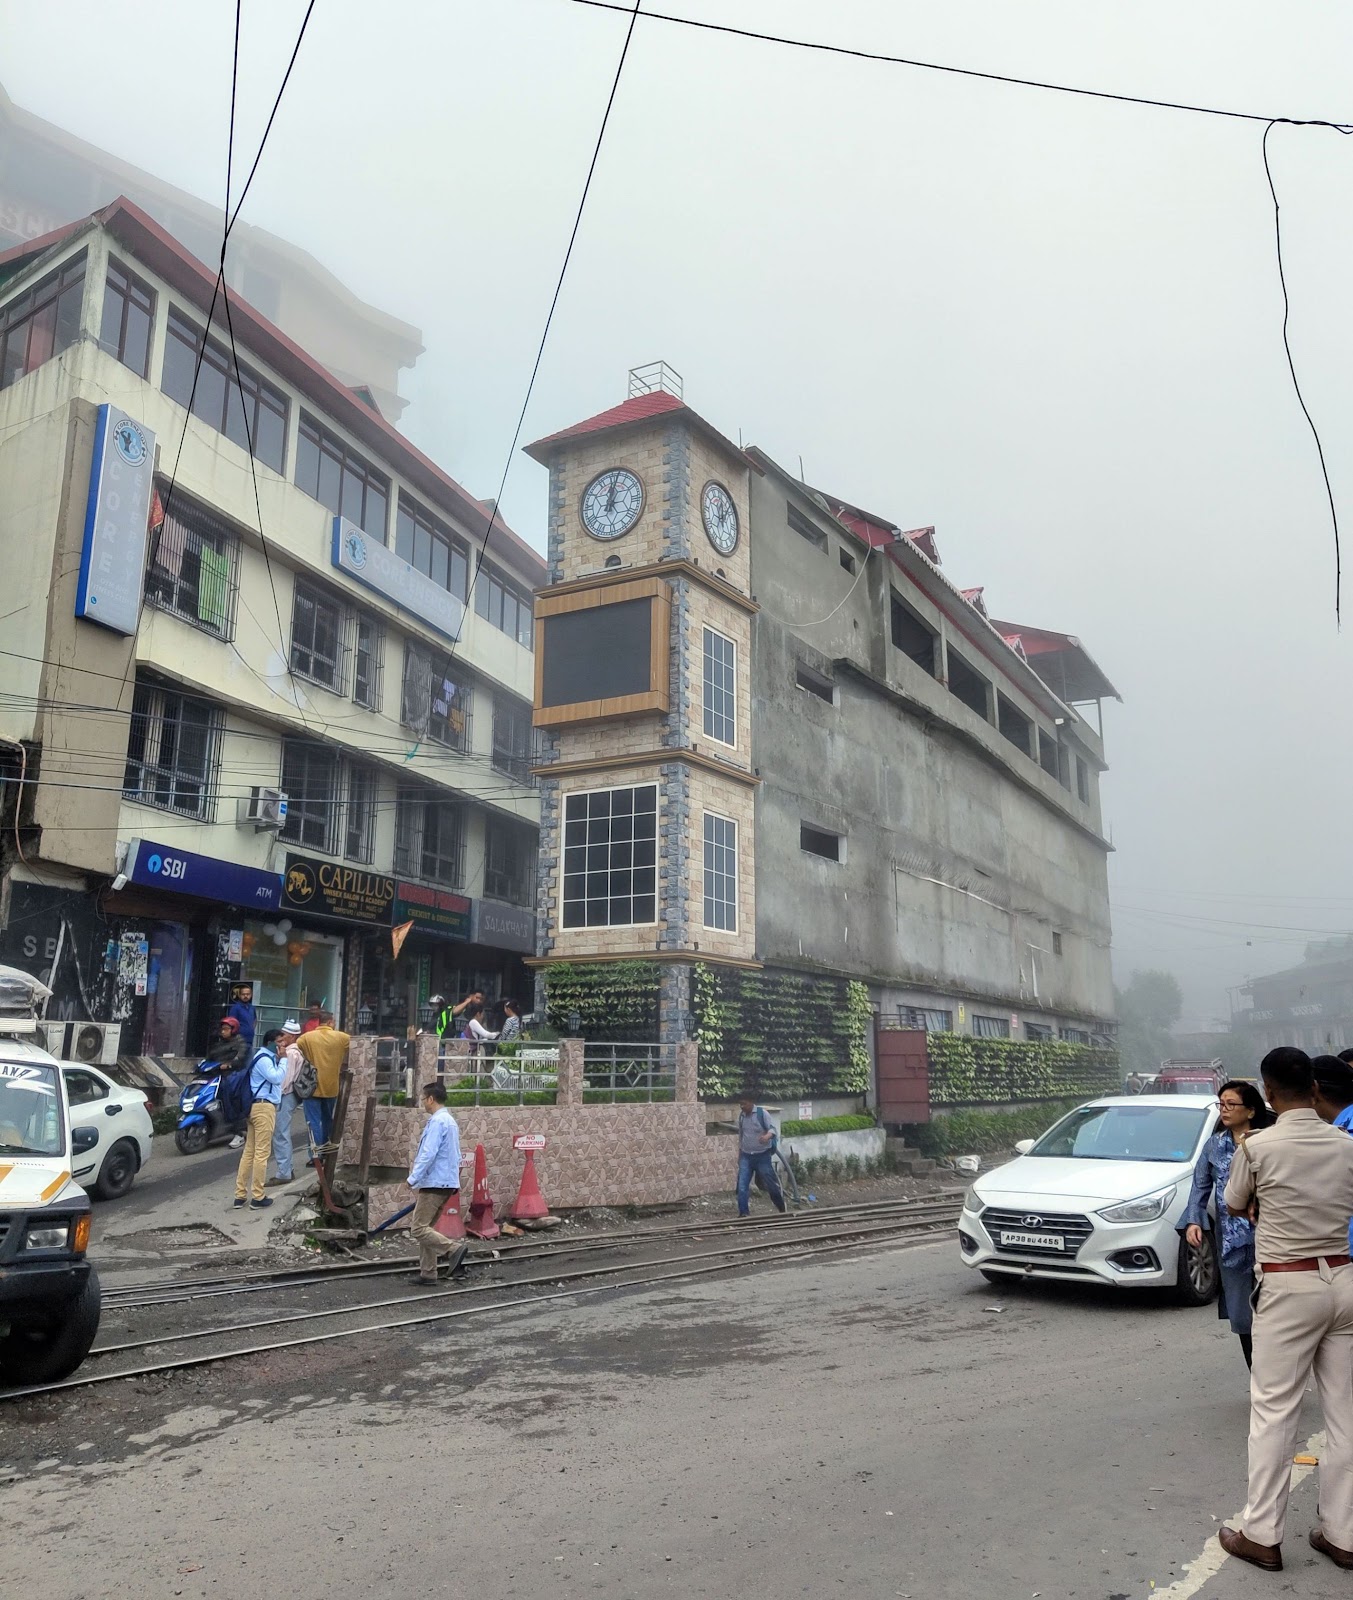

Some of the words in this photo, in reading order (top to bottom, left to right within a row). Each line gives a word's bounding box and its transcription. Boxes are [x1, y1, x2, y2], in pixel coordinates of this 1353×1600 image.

[98, 460, 122, 573] CORE
[161, 857, 187, 880] SBI
[255, 887, 273, 899] ATM
[319, 864, 394, 900] CAPILLUS
[323, 888, 343, 898] UNISEX
[343, 891, 360, 901] SALON
[365, 896, 388, 907] ACADEMY
[407, 908, 431, 920] CHEMIST
